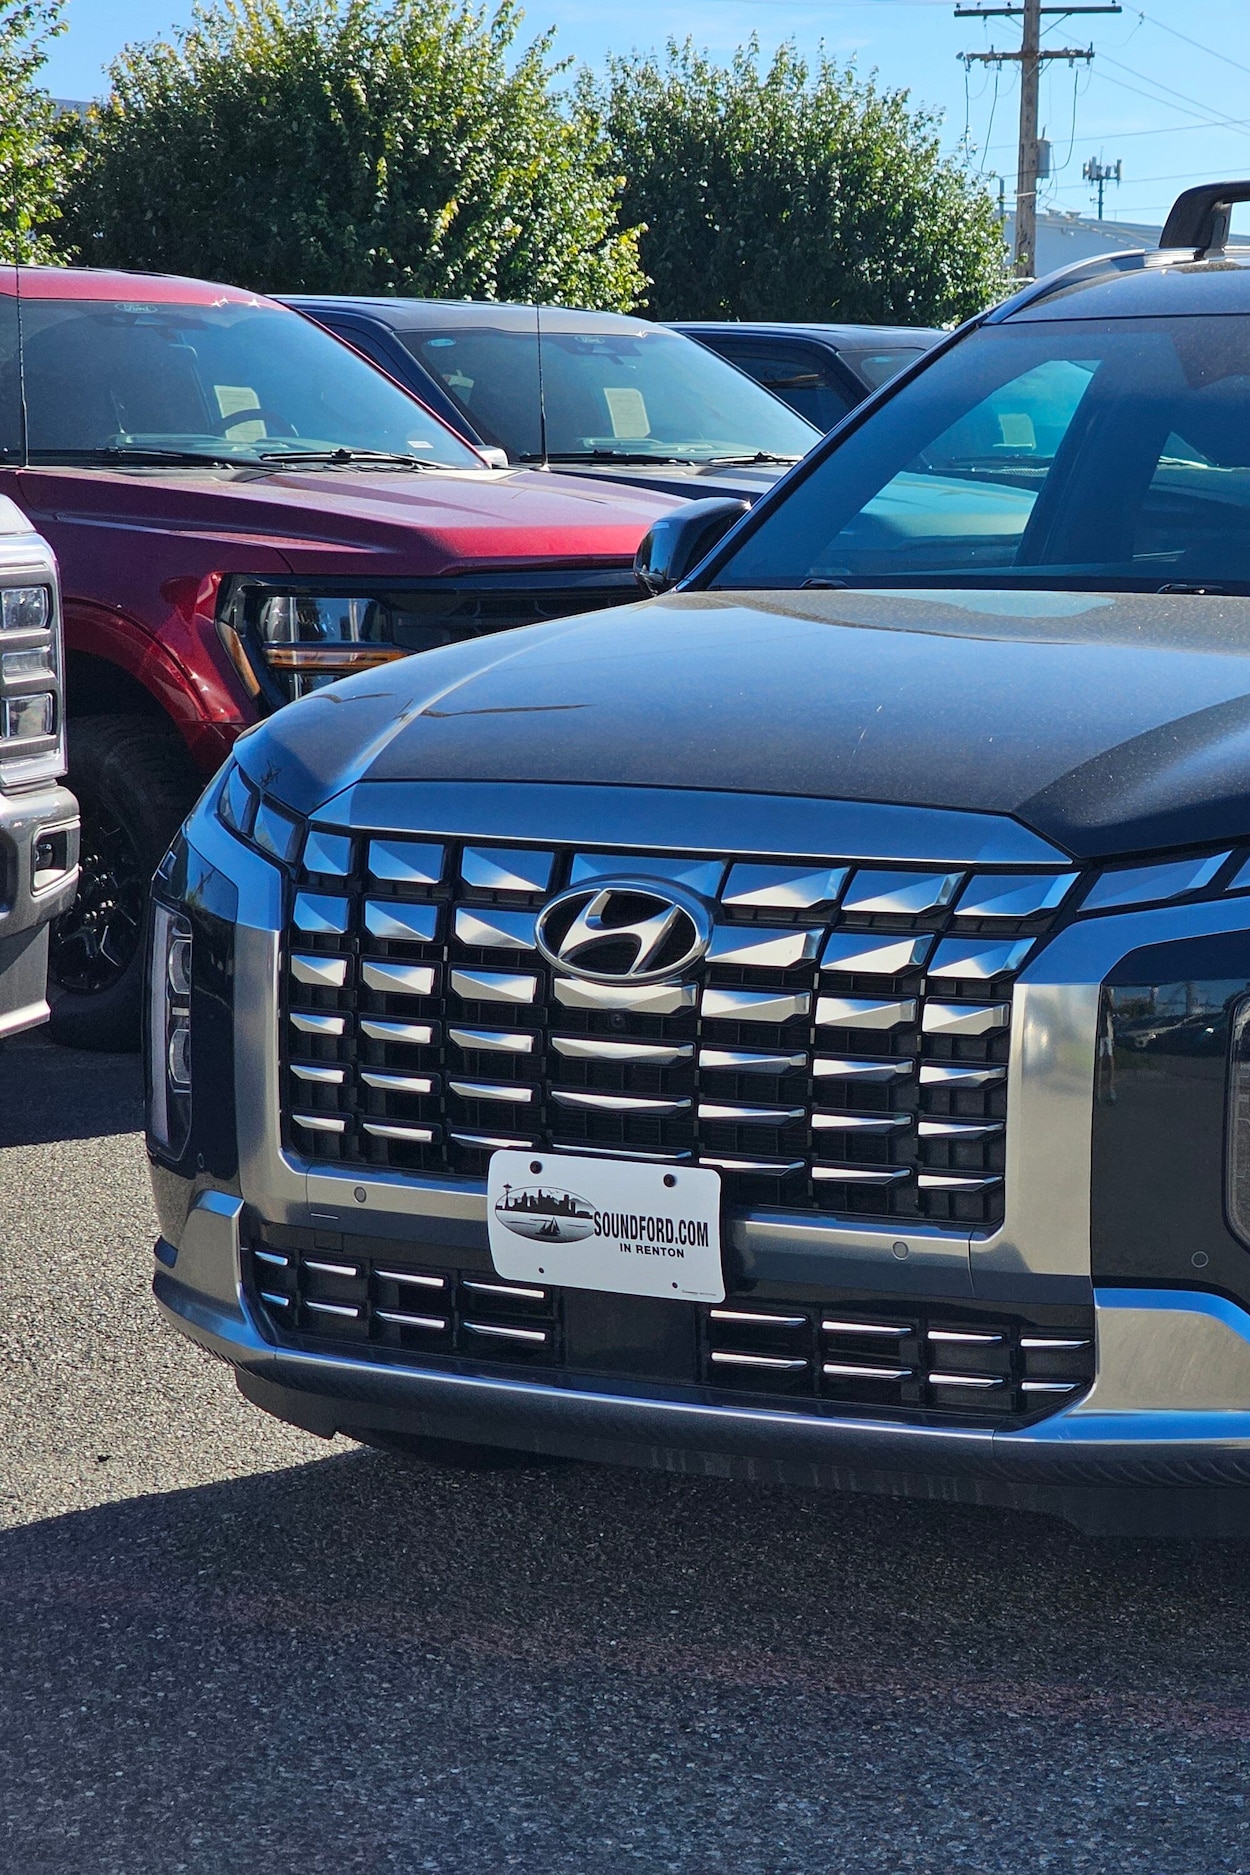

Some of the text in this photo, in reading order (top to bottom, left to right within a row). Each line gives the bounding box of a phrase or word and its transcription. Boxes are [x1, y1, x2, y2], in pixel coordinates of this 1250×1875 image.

[593, 1210, 710, 1248] SOUNDFORD.COM
[619, 1242, 685, 1259] IN RENTON
